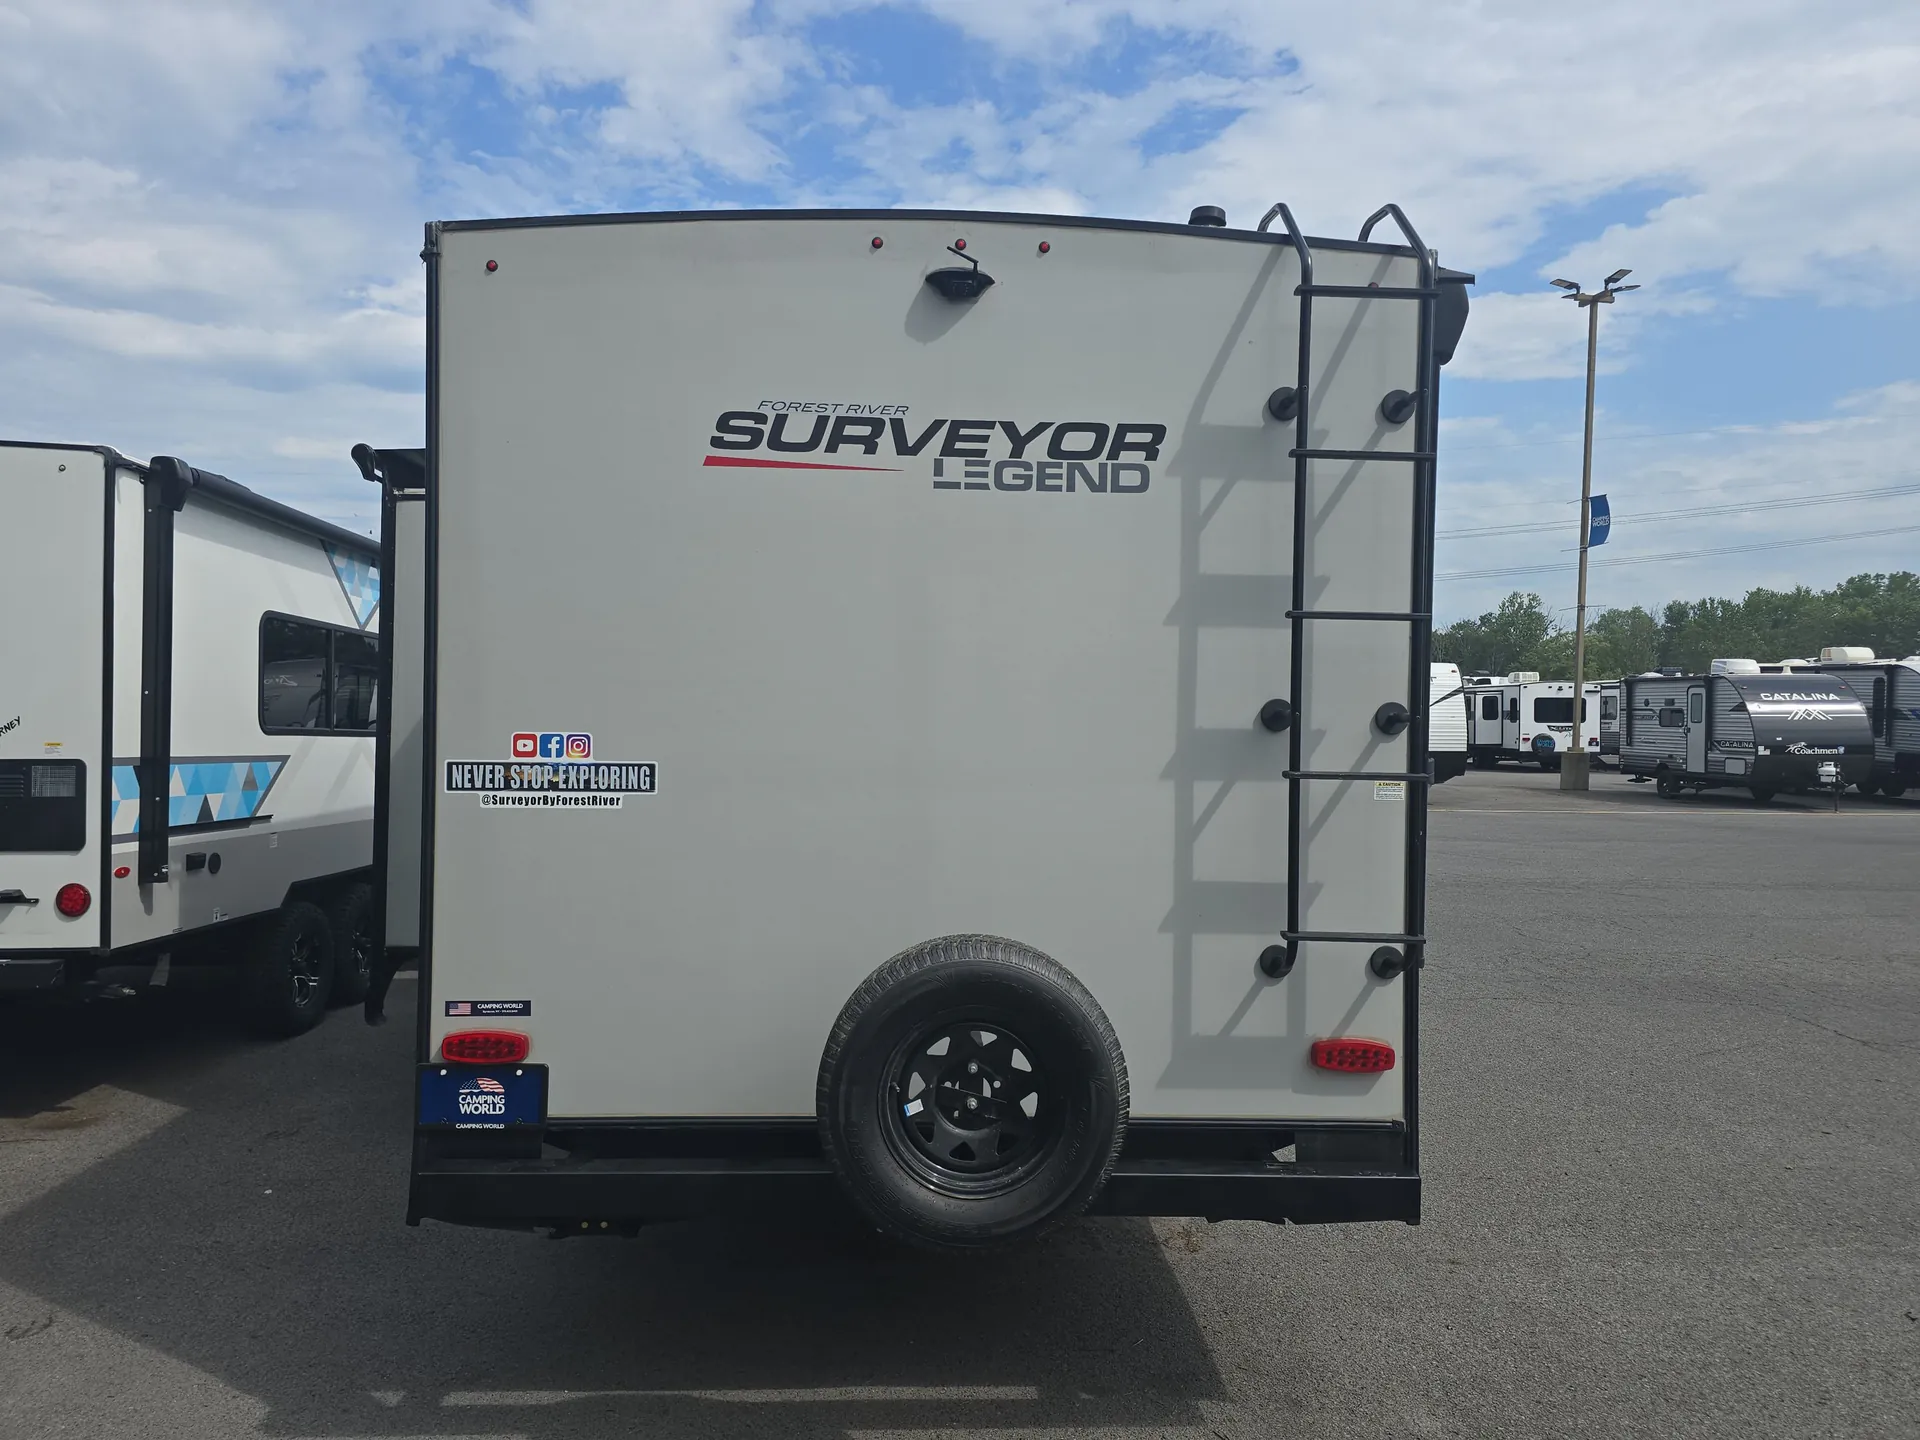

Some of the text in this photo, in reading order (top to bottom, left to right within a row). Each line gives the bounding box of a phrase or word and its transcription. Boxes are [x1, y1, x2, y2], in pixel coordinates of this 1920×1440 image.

[757, 400, 910, 416] FOREST RIVER
[709, 410, 1168, 462] SURVEYOR
[933, 458, 1151, 494] LEGEND
[1760, 693, 1841, 701] CATALINA
[1720, 740, 1754, 748] CATALINA
[1794, 747, 1838, 755] Coachmen
[451, 764, 651, 790] NEVER STOP EXPLORING
[481, 794, 621, 807] @SurveyorByForestRiver
[458, 1095, 505, 1104] CAMPING
[459, 1104, 505, 1115] WORLD
